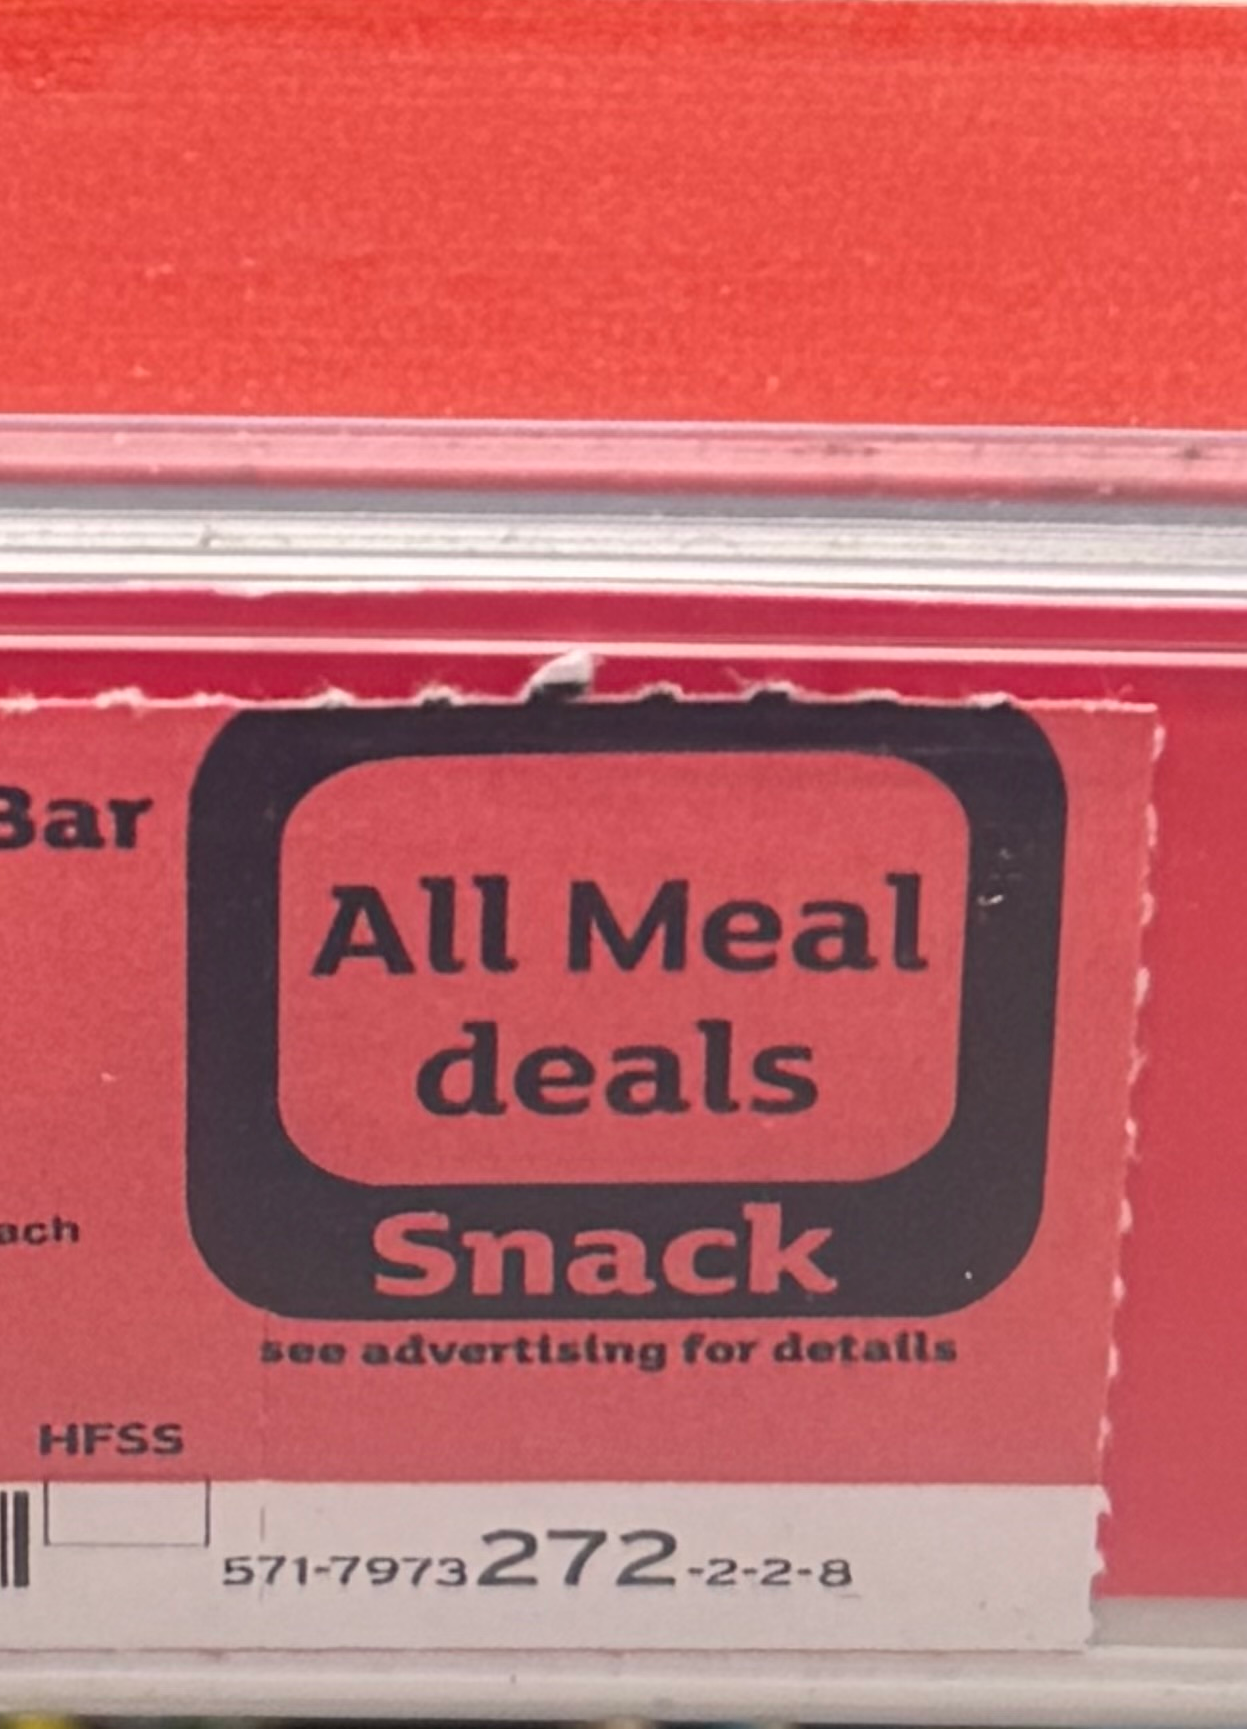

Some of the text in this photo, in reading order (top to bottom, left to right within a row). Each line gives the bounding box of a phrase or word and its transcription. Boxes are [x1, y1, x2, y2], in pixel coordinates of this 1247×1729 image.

[312, 873, 927, 977] All Meal
[416, 1019, 817, 1116] deals
[370, 1201, 838, 1297] Snack
[261, 1331, 957, 1373] see advertising for details
[39, 1422, 183, 1456] HFSS
